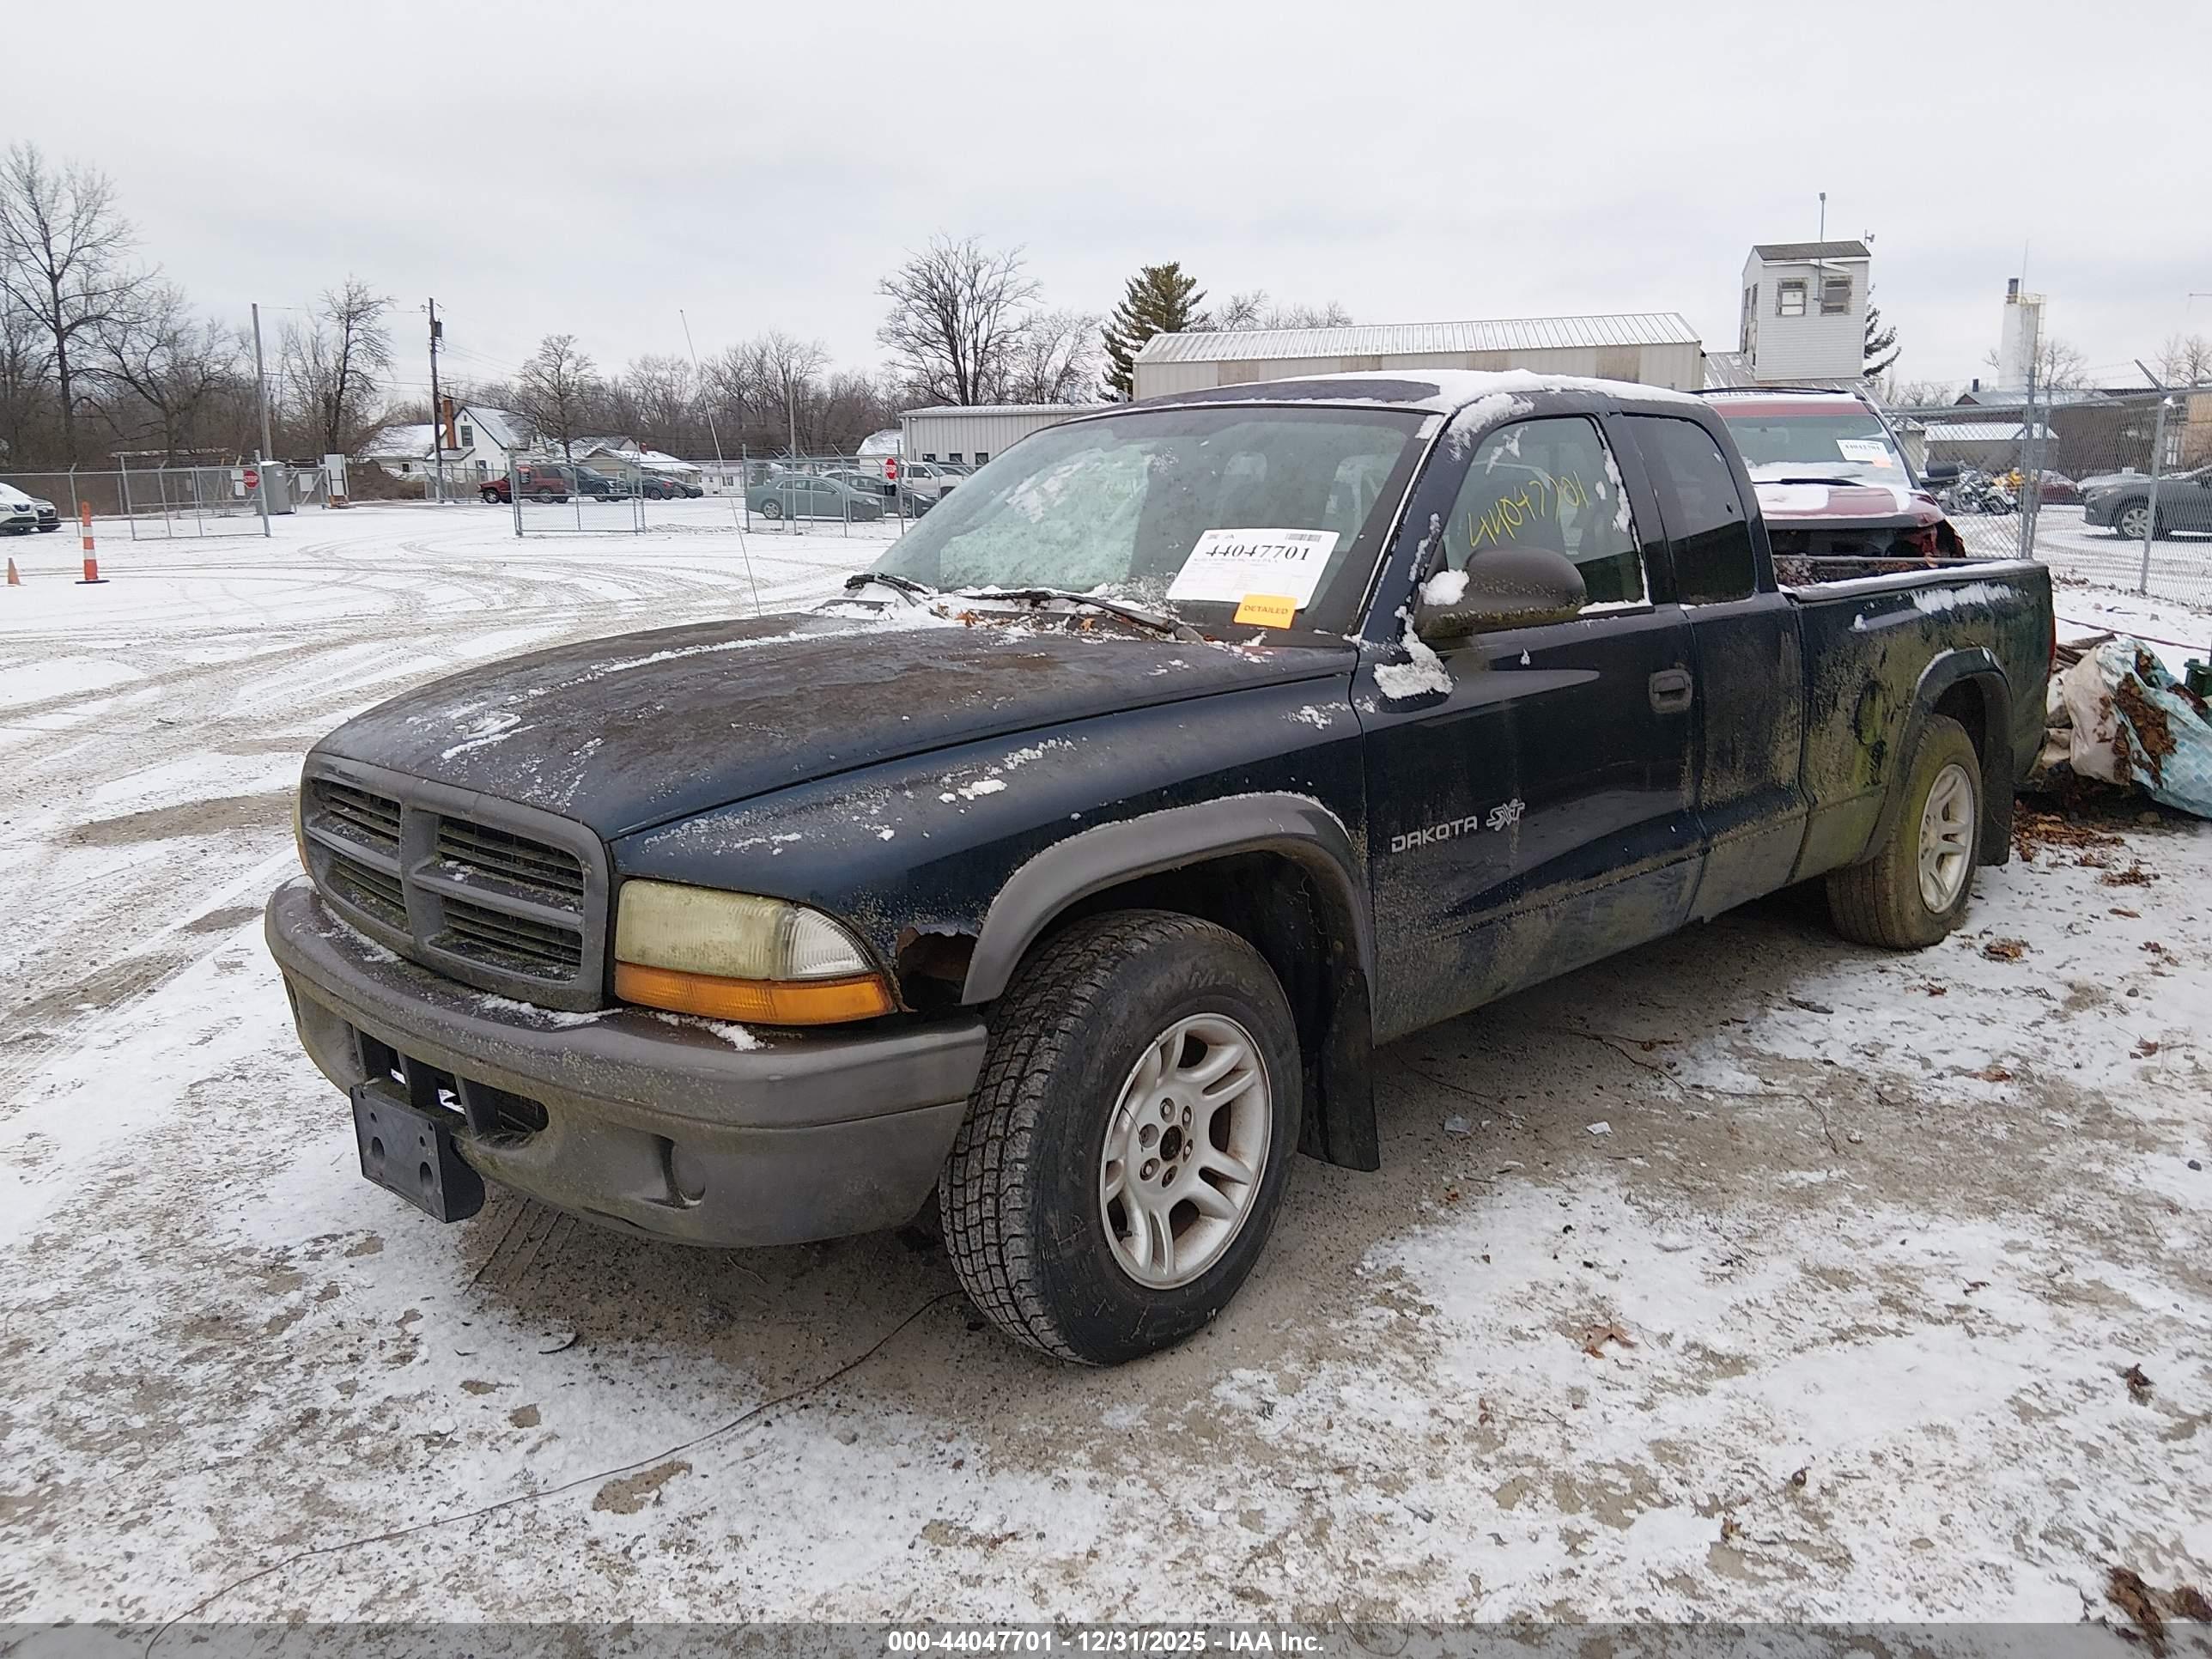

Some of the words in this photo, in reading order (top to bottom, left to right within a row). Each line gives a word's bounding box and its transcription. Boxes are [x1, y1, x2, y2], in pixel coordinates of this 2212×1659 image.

[1467, 471, 1589, 548] 44047701
[1206, 544, 1310, 561] 44047701
[1243, 605, 1289, 615] DETAILED
[1391, 815, 1478, 853] DAKOTA
[1486, 799, 1525, 831] SXT
